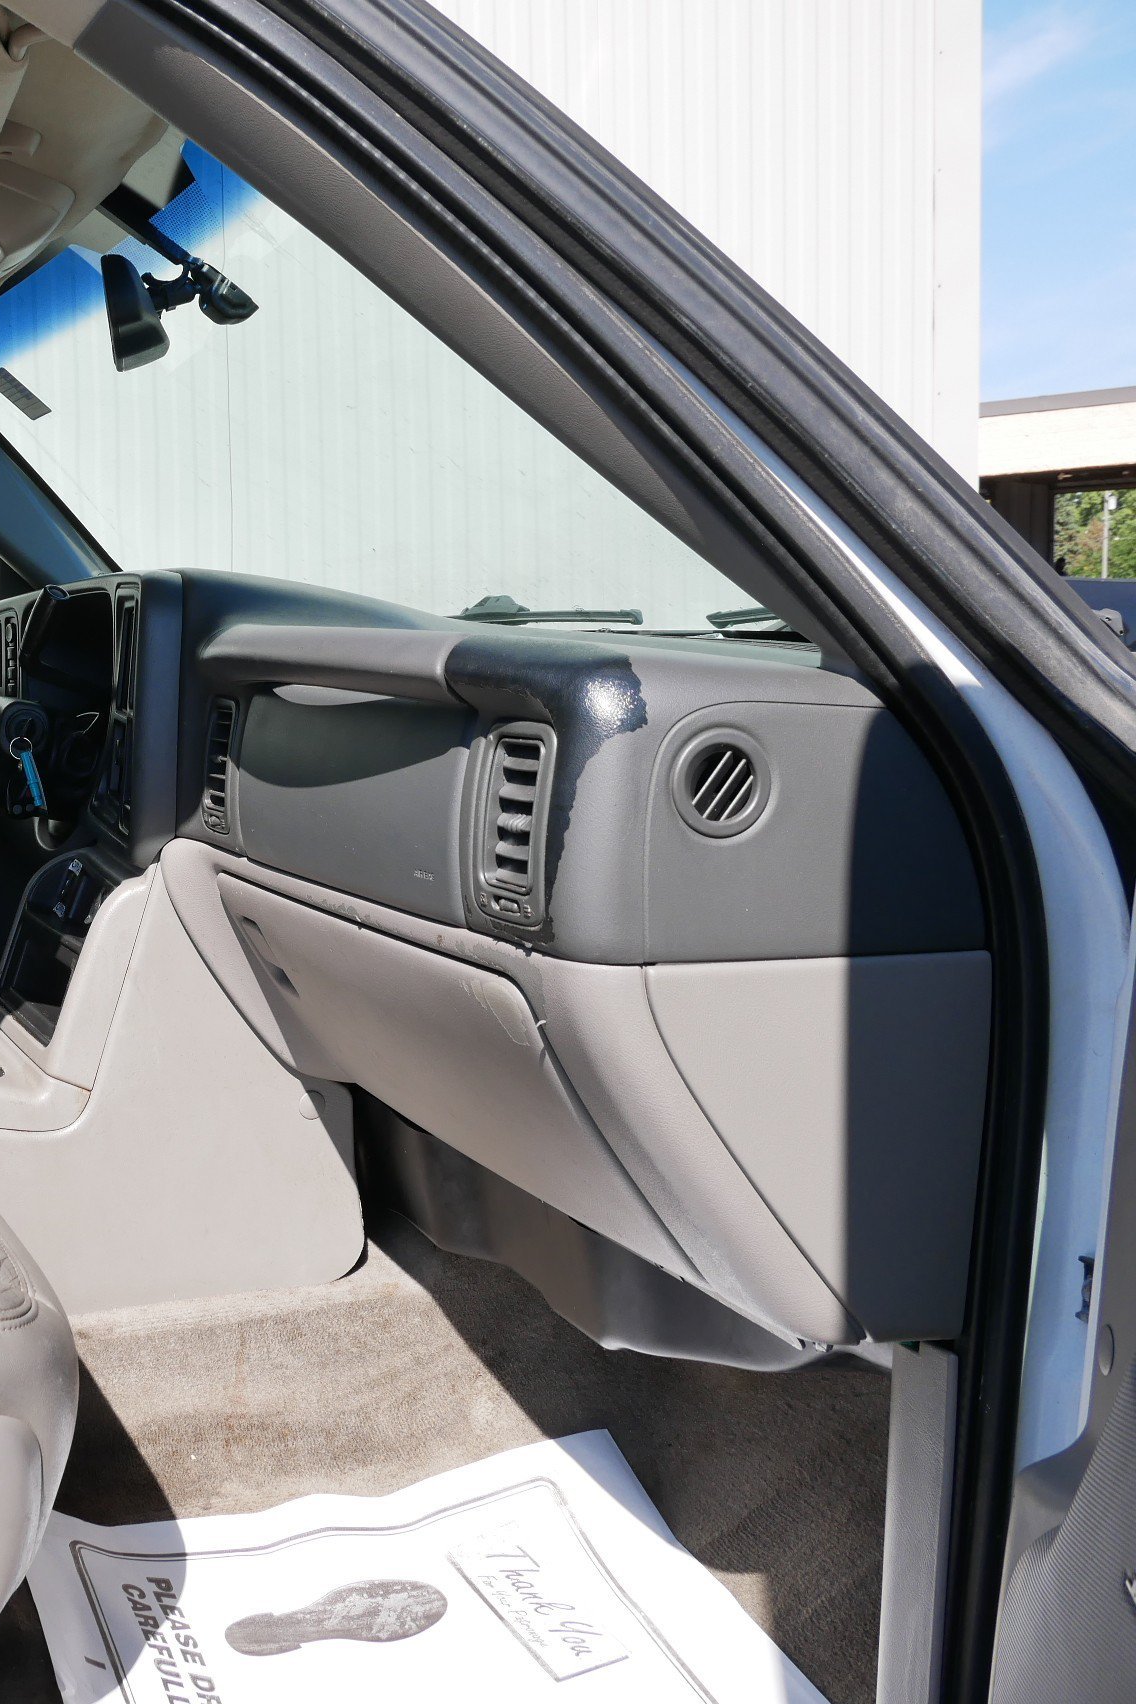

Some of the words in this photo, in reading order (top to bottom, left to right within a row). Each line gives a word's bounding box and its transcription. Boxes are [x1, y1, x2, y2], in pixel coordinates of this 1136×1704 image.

[145, 1576, 207, 1667] PLEASE
[485, 1545, 576, 1616] Thank
[548, 1621, 604, 1657] You
